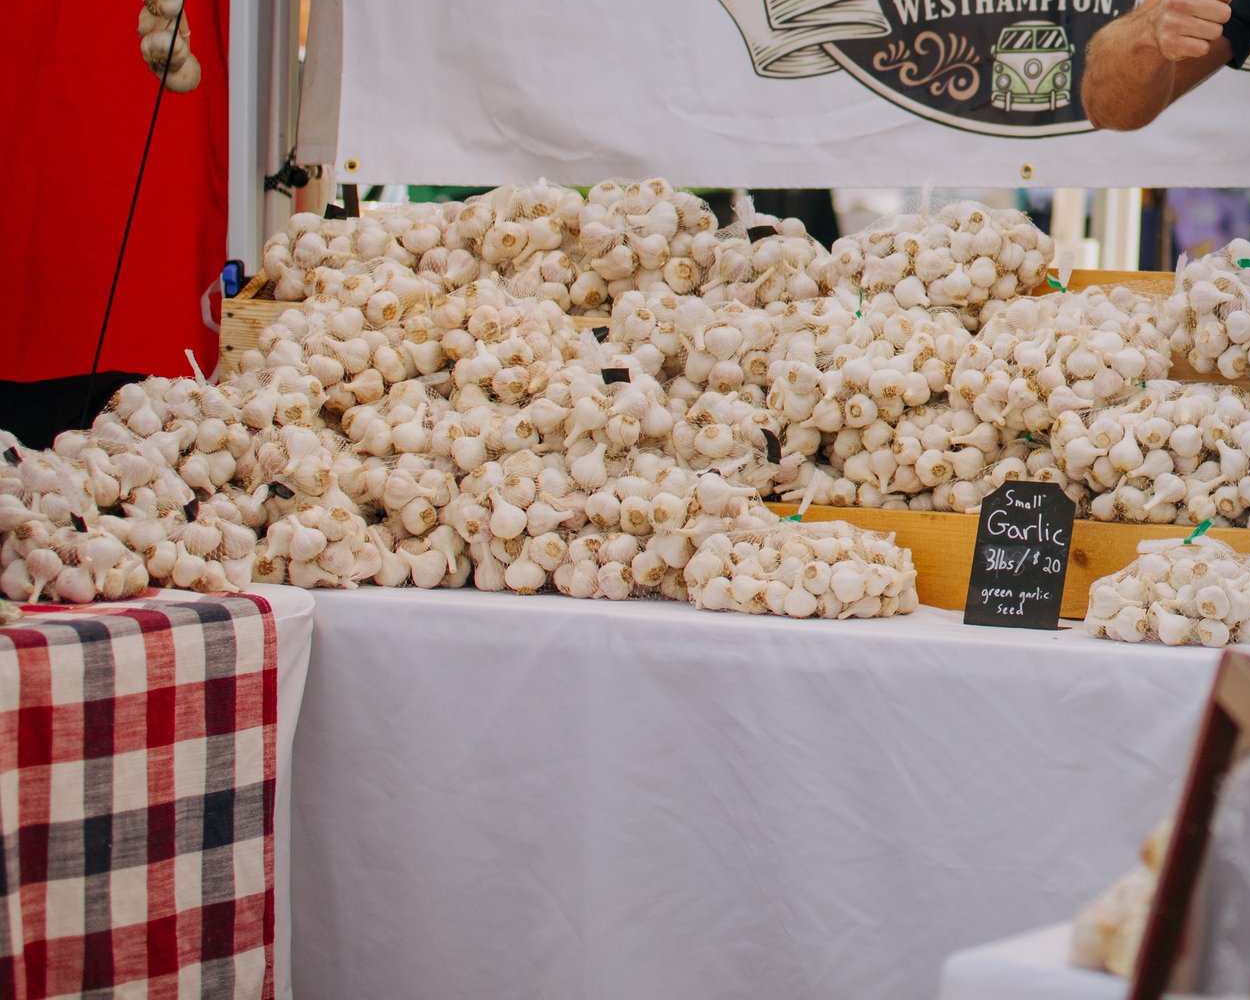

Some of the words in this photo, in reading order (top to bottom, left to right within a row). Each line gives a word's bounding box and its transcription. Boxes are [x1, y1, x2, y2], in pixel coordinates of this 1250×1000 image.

[1005, 489, 1043, 510] Small
[987, 509, 1065, 546] Garlic
[981, 586, 1013, 605] green
[1018, 586, 1051, 604] garlic
[996, 602, 1025, 616] seed
